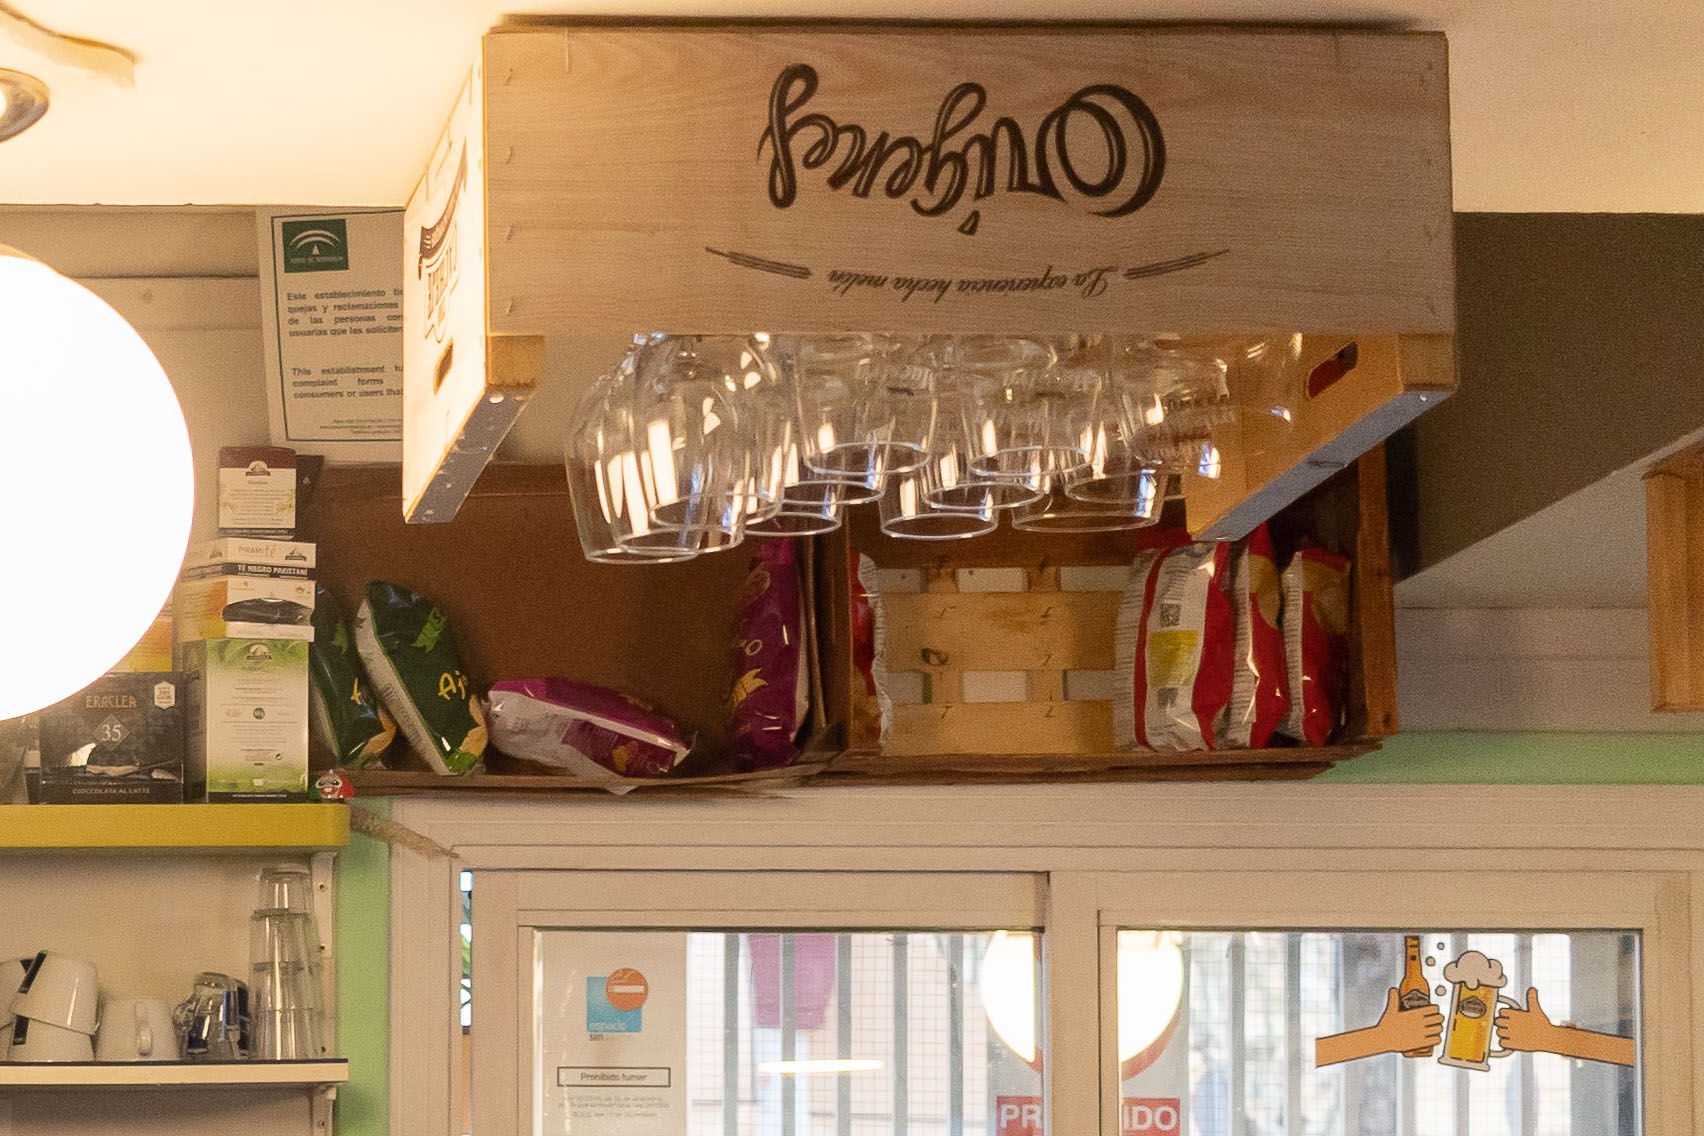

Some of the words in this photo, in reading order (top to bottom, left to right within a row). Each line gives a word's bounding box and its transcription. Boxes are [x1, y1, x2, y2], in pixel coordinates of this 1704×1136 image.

[957, 265, 1068, 298] experiencia
[1073, 265, 1118, 298] La
[314, 289, 386, 300] establecimiento
[894, 276, 951, 304] hecha
[322, 304, 328, 313] y
[333, 301, 398, 311] reclamaciones
[287, 317, 299, 325] de
[310, 316, 323, 324] las
[334, 314, 375, 324] personas
[289, 328, 328, 337] usuarias
[329, 328, 347, 337] que
[349, 326, 363, 334] las
[291, 367, 311, 376] This
[321, 365, 385, 375] establishment
[292, 379, 337, 388] complaint
[357, 377, 384, 386] forms
[293, 390, 343, 399] consumers
[359, 389, 384, 397] users
[101, 724, 122, 742] 35
[580, 1072, 620, 1081] Prohibido
[621, 1072, 648, 1081] fumar
